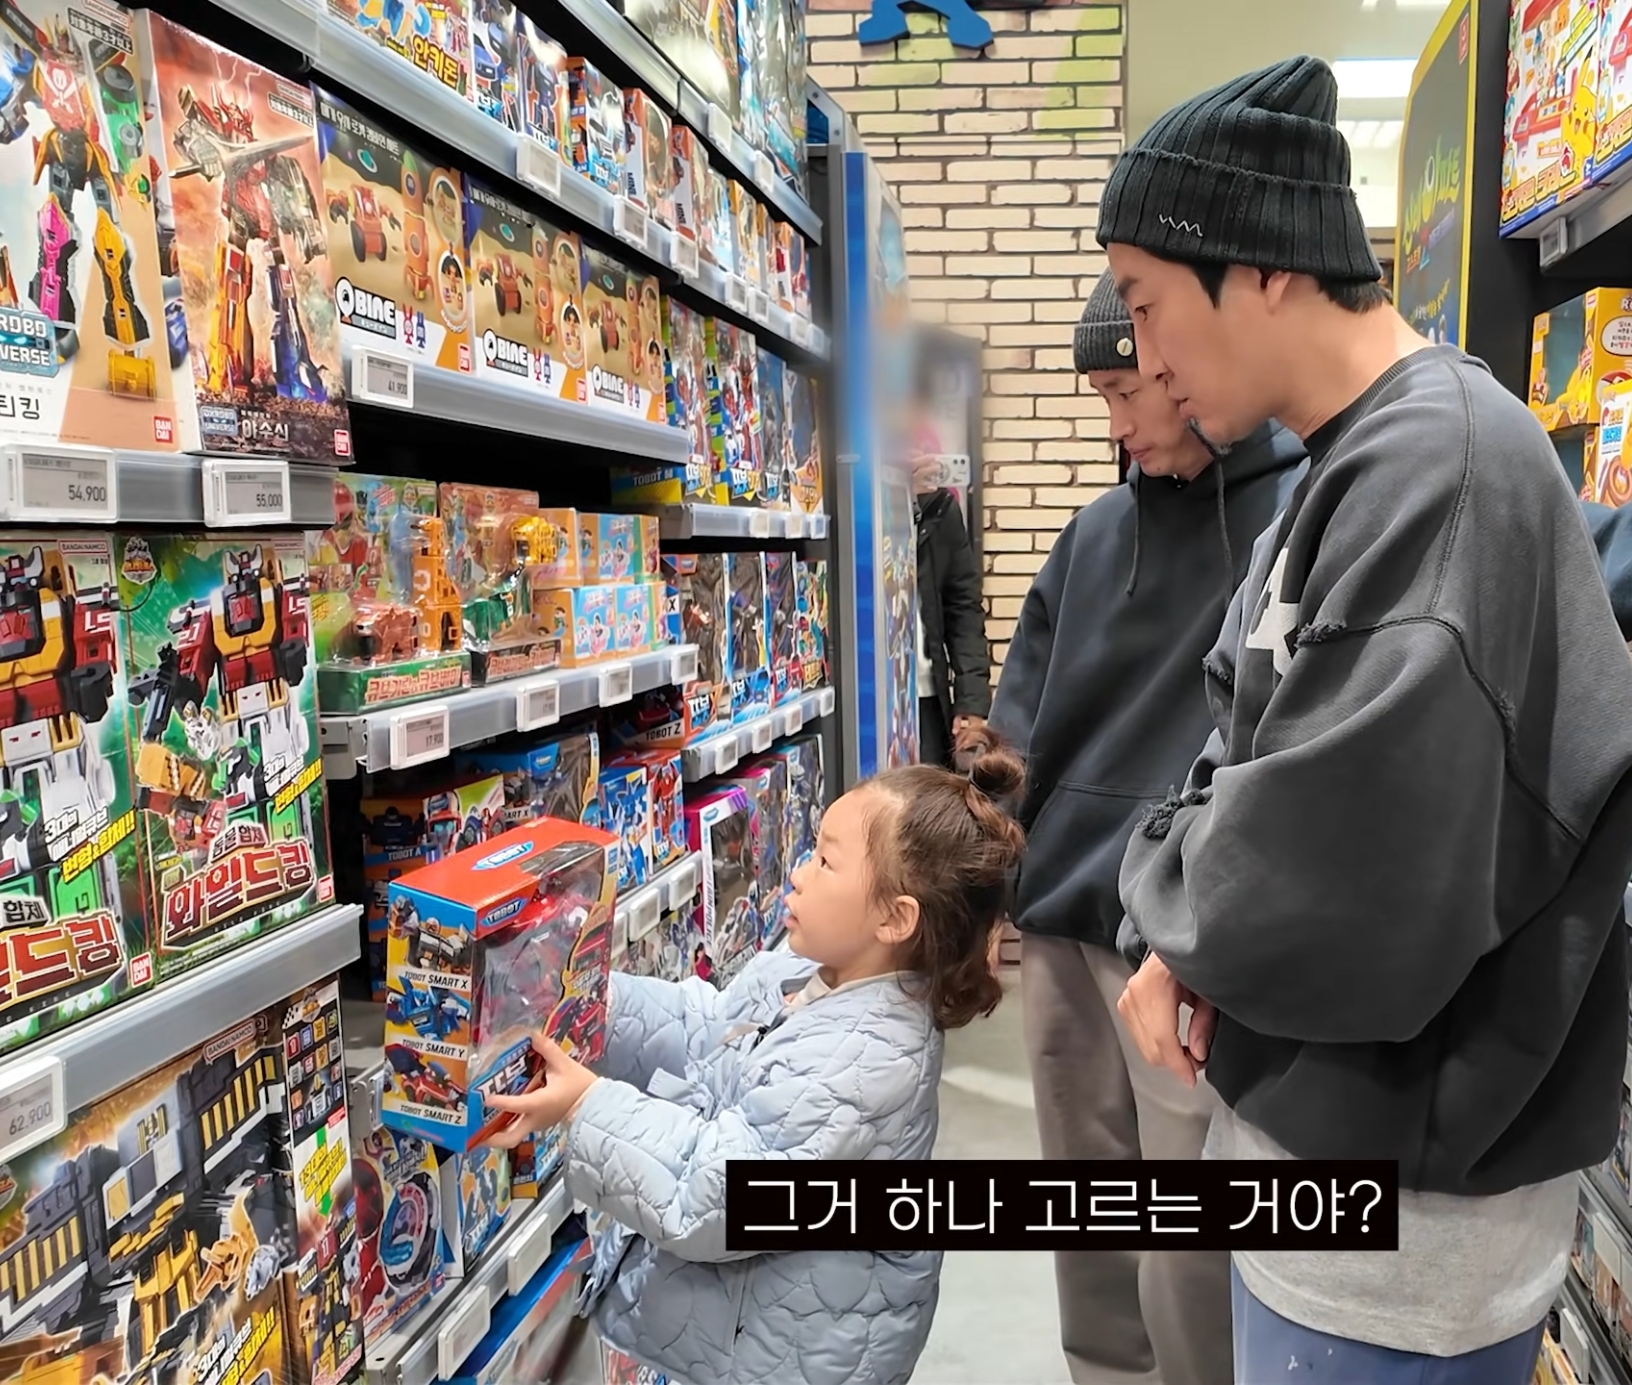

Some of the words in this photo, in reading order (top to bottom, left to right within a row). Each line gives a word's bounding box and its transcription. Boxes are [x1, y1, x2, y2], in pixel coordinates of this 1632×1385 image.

[414, 36, 458, 89] 안키돈
[242, 420, 288, 442] 야수신
[633, 471, 662, 486] TOBOT
[669, 598, 677, 612] X
[646, 726, 672, 741] TOBOT
[673, 722, 681, 735] Z
[504, 811, 523, 820] ART
[388, 848, 413, 861] TOBOT
[167, 842, 314, 940] 와일드킹
[487, 899, 521, 923] TOBOT
[405, 971, 426, 982] TOBOT
[428, 974, 460, 988] SMART
[461, 979, 468, 989] X
[402, 1039, 424, 1050] TOBOT
[425, 1043, 456, 1057] SMART
[458, 1049, 465, 1058] Y
[400, 1105, 422, 1115] TOBOT
[424, 1109, 454, 1123] SMART
[455, 1115, 462, 1124] Z
